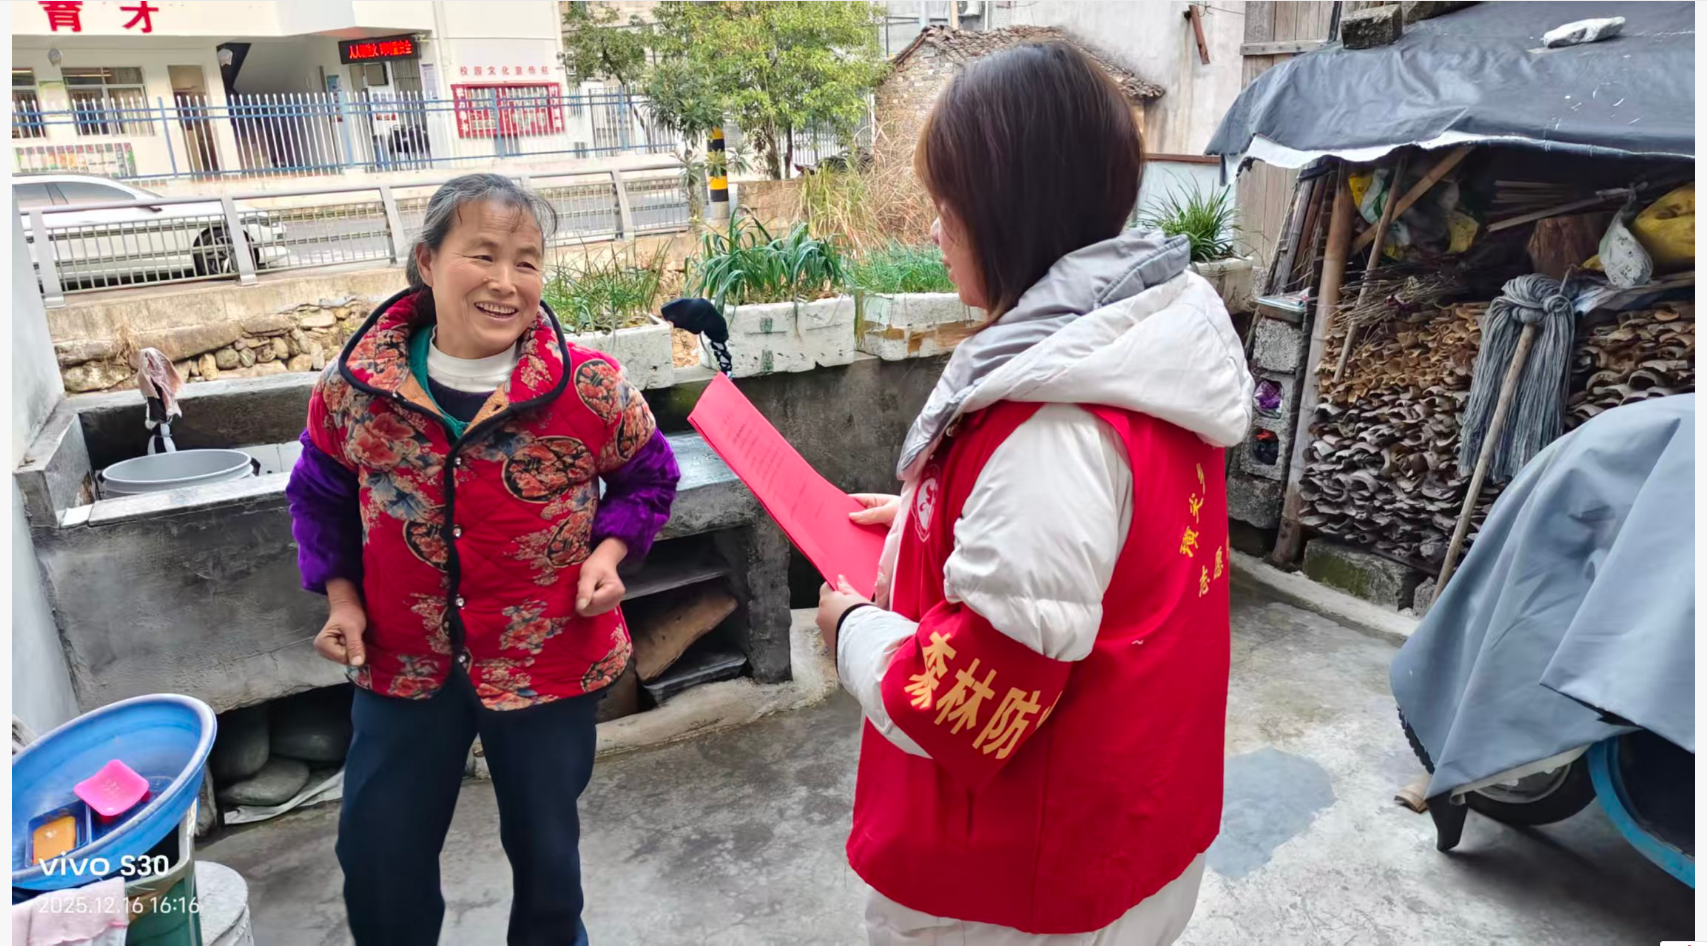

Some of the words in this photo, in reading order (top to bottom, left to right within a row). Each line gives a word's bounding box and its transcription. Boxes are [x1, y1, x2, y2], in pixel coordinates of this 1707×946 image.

[38, 1, 159, 33] 育才
[903, 631, 1063, 760] 森林防
